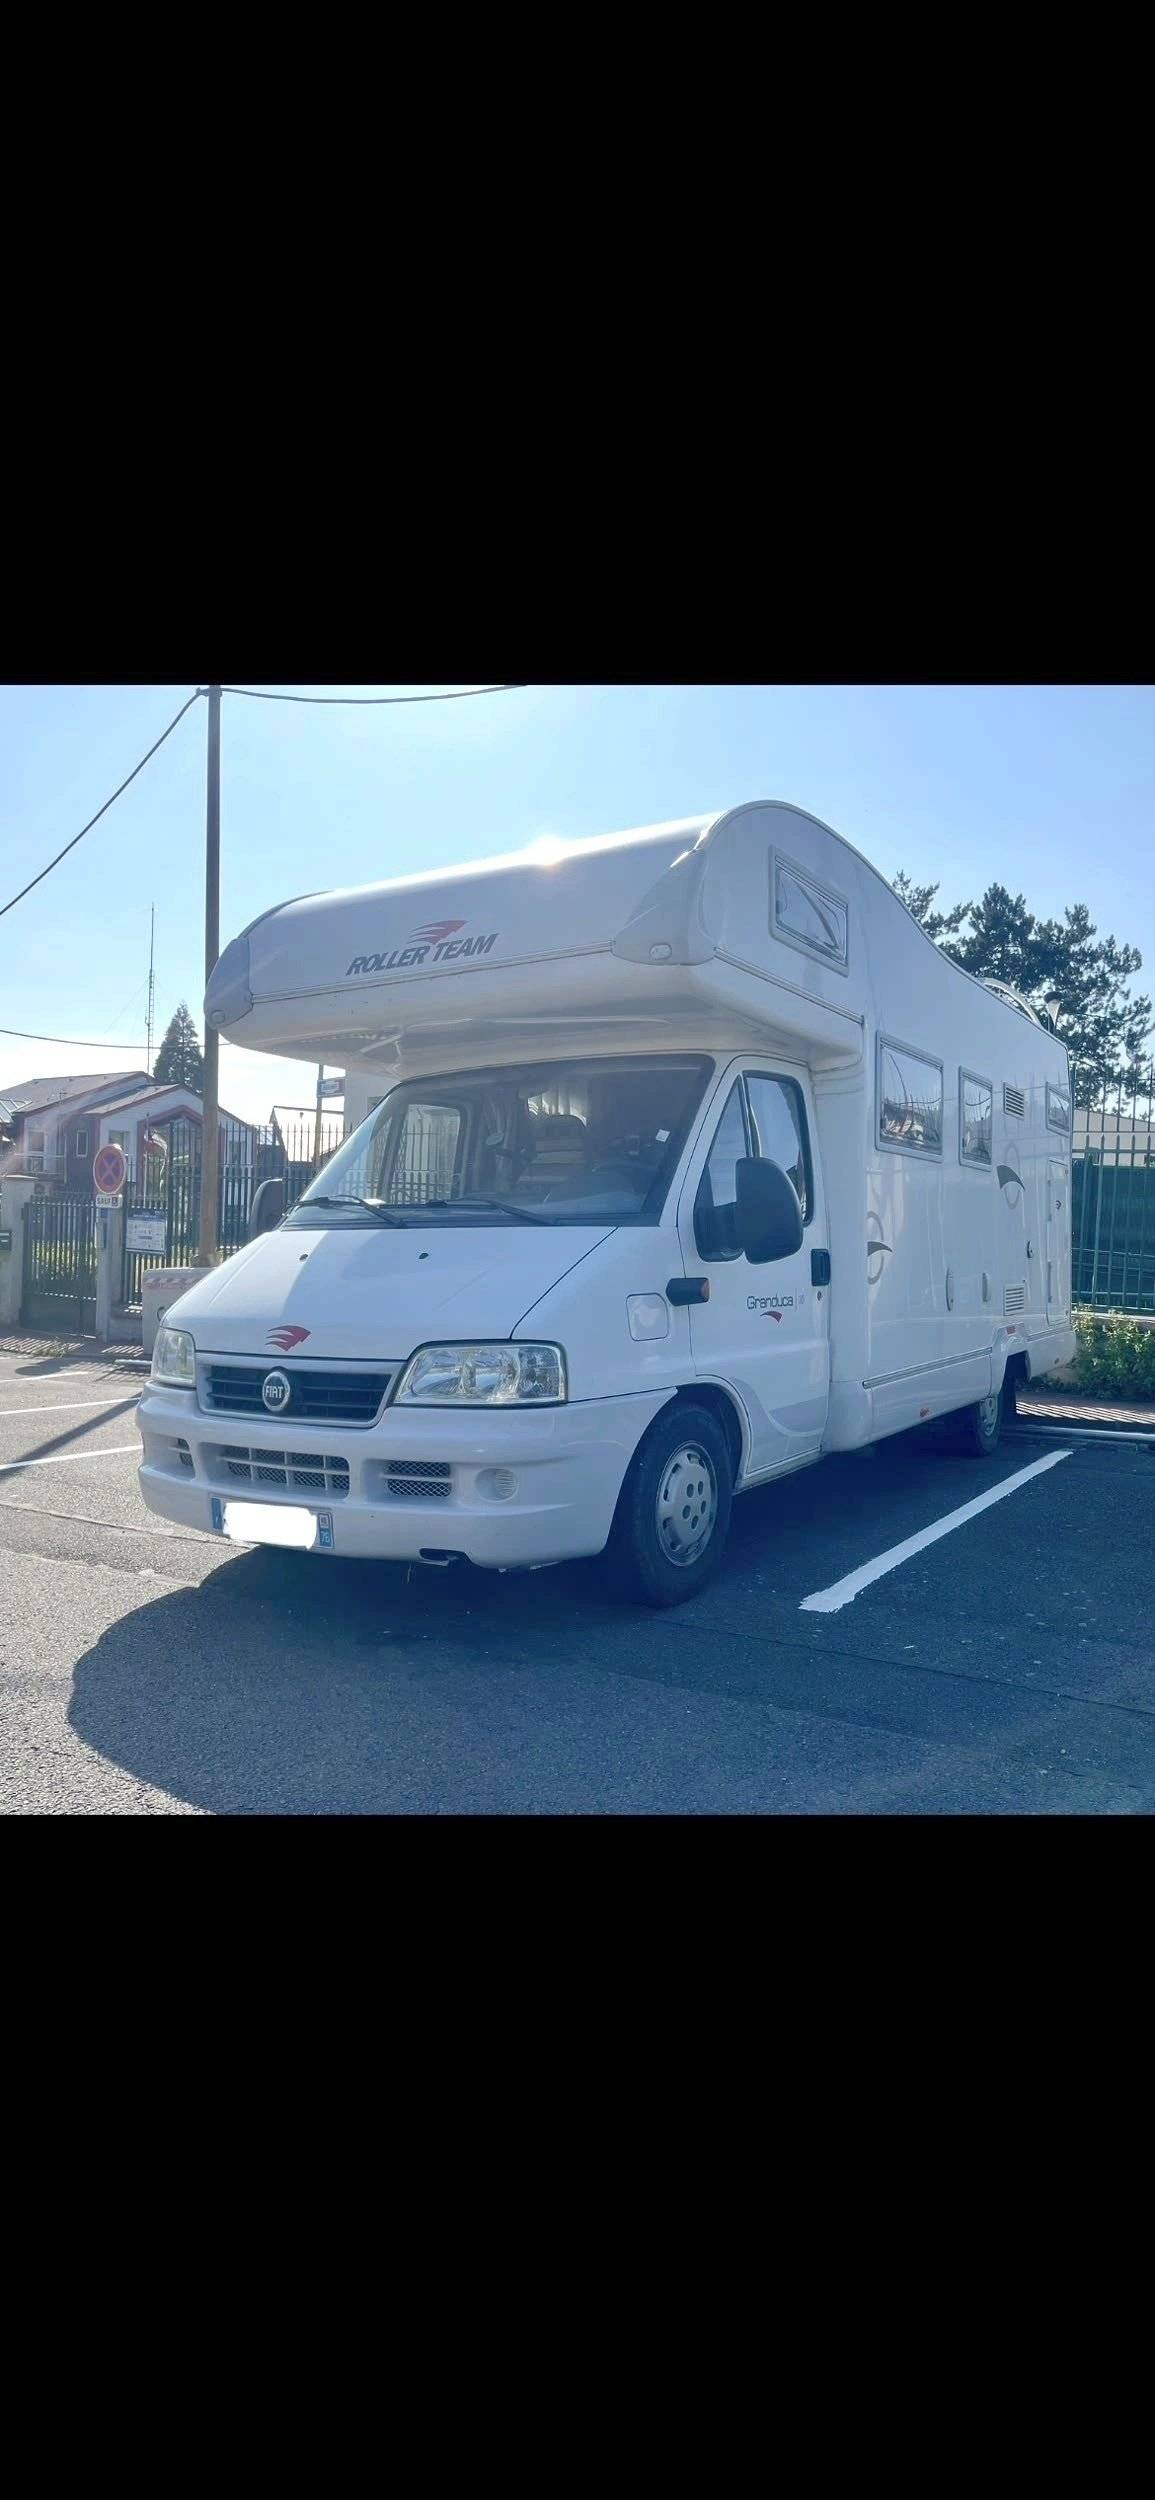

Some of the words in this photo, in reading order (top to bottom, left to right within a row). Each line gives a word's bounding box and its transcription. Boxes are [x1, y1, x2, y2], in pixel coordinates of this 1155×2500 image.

[346, 946, 431, 977] ROLLER
[432, 933, 500, 962] TEAM
[746, 1294, 794, 1310] Granduca
[265, 1385, 284, 1399] FIAT
